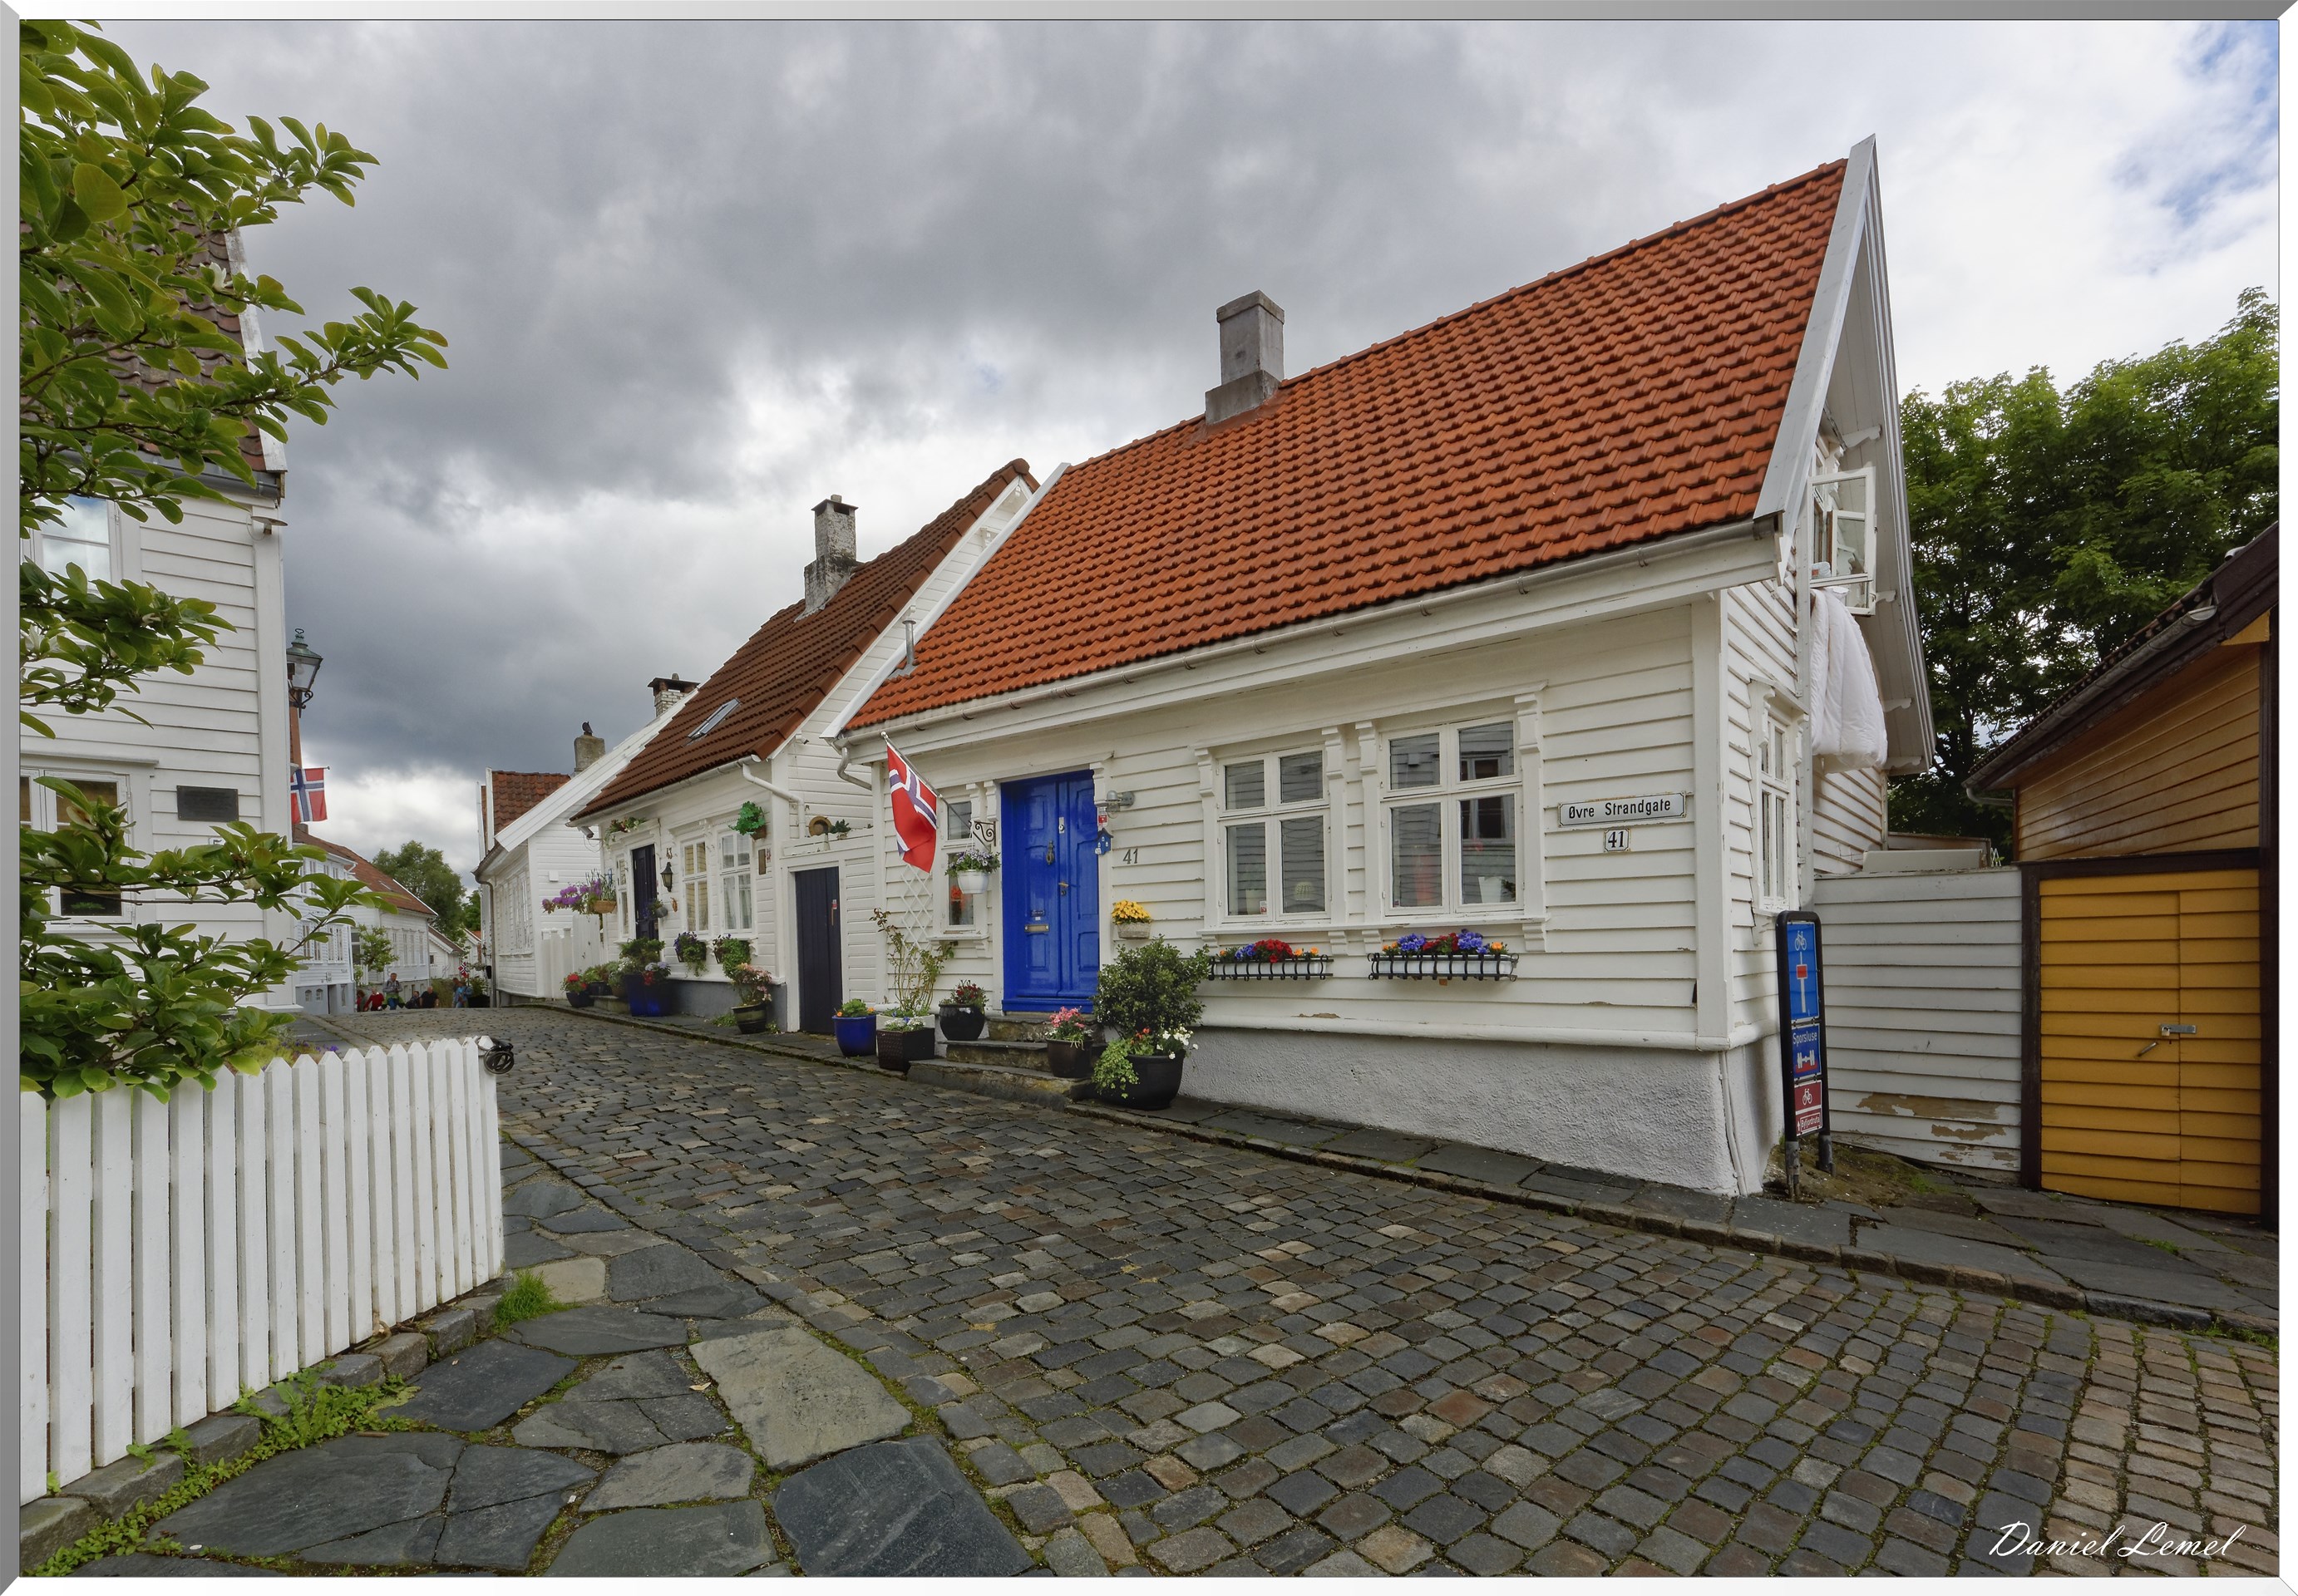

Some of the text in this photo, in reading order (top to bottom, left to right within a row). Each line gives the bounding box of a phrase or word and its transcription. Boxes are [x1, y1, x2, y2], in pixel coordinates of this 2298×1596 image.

[1569, 799, 1671, 819] Øvre Strandgate
[1607, 831, 1625, 848] 41
[1122, 848, 1138, 864] 41
[1793, 1031, 1817, 1047] Sporsluse
